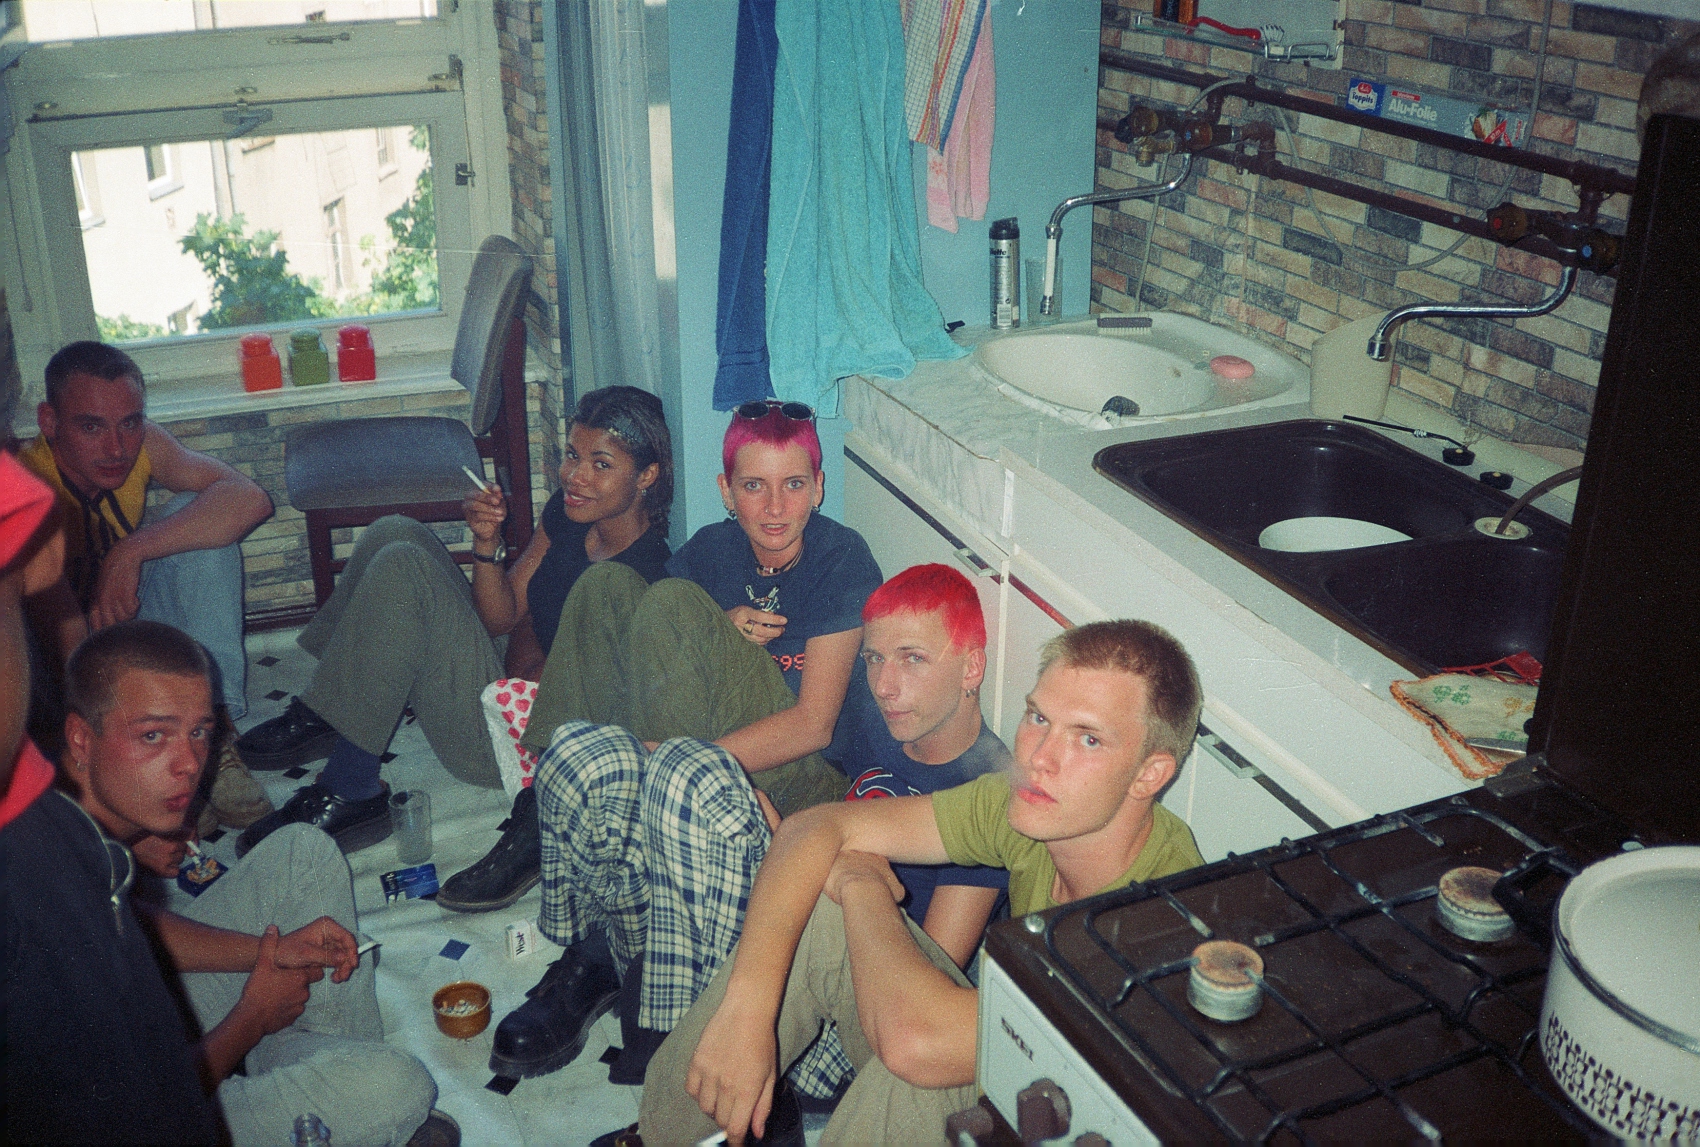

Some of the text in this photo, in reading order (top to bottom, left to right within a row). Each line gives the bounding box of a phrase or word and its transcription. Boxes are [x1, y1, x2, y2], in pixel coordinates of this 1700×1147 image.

[1352, 92, 1374, 104] Toppits
[1388, 98, 1438, 121] Alu-Folie
[515, 931, 526, 956] West
